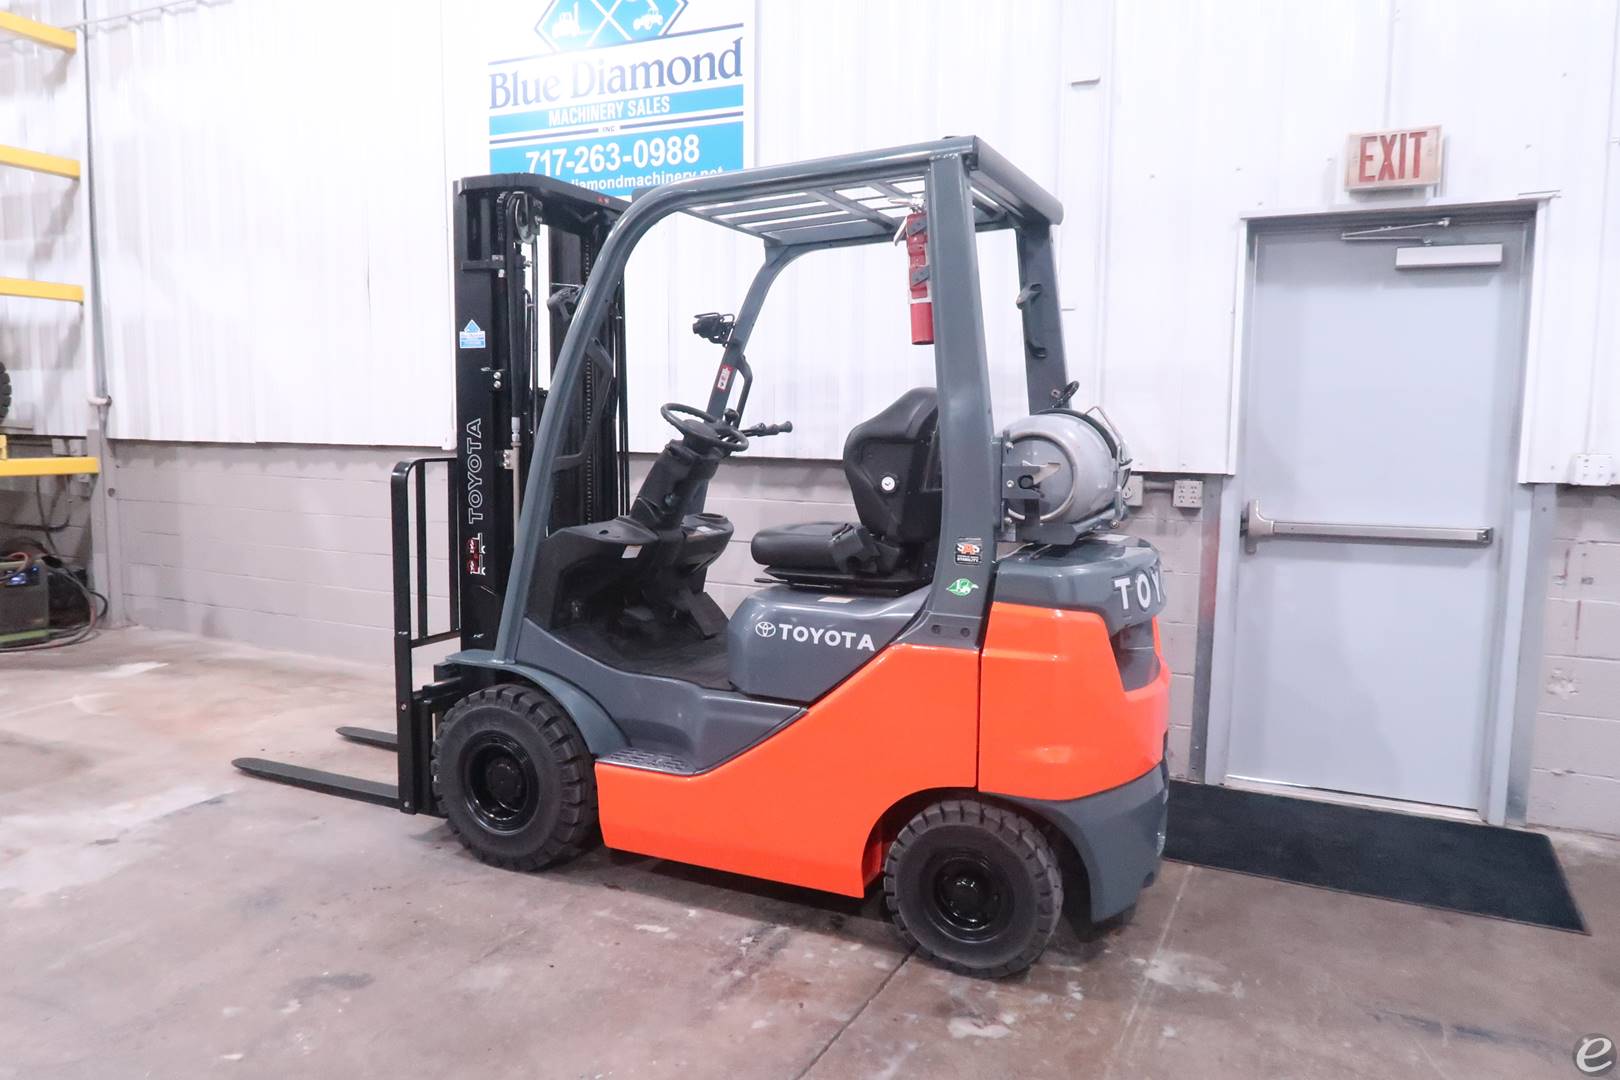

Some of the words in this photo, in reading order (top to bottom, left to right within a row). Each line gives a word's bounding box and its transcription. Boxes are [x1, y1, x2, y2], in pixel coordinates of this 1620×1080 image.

[489, 70, 561, 109] Blue
[570, 37, 743, 98] Diamond
[548, 101, 624, 127] MACHINERY
[627, 96, 670, 116] SALES
[525, 134, 700, 176] 717-263-0988
[1359, 131, 1427, 182] EXIT
[571, 166, 723, 190] iamondmachinerynet
[467, 418, 483, 525] TOYOTA
[779, 623, 875, 651] TOYOTA
